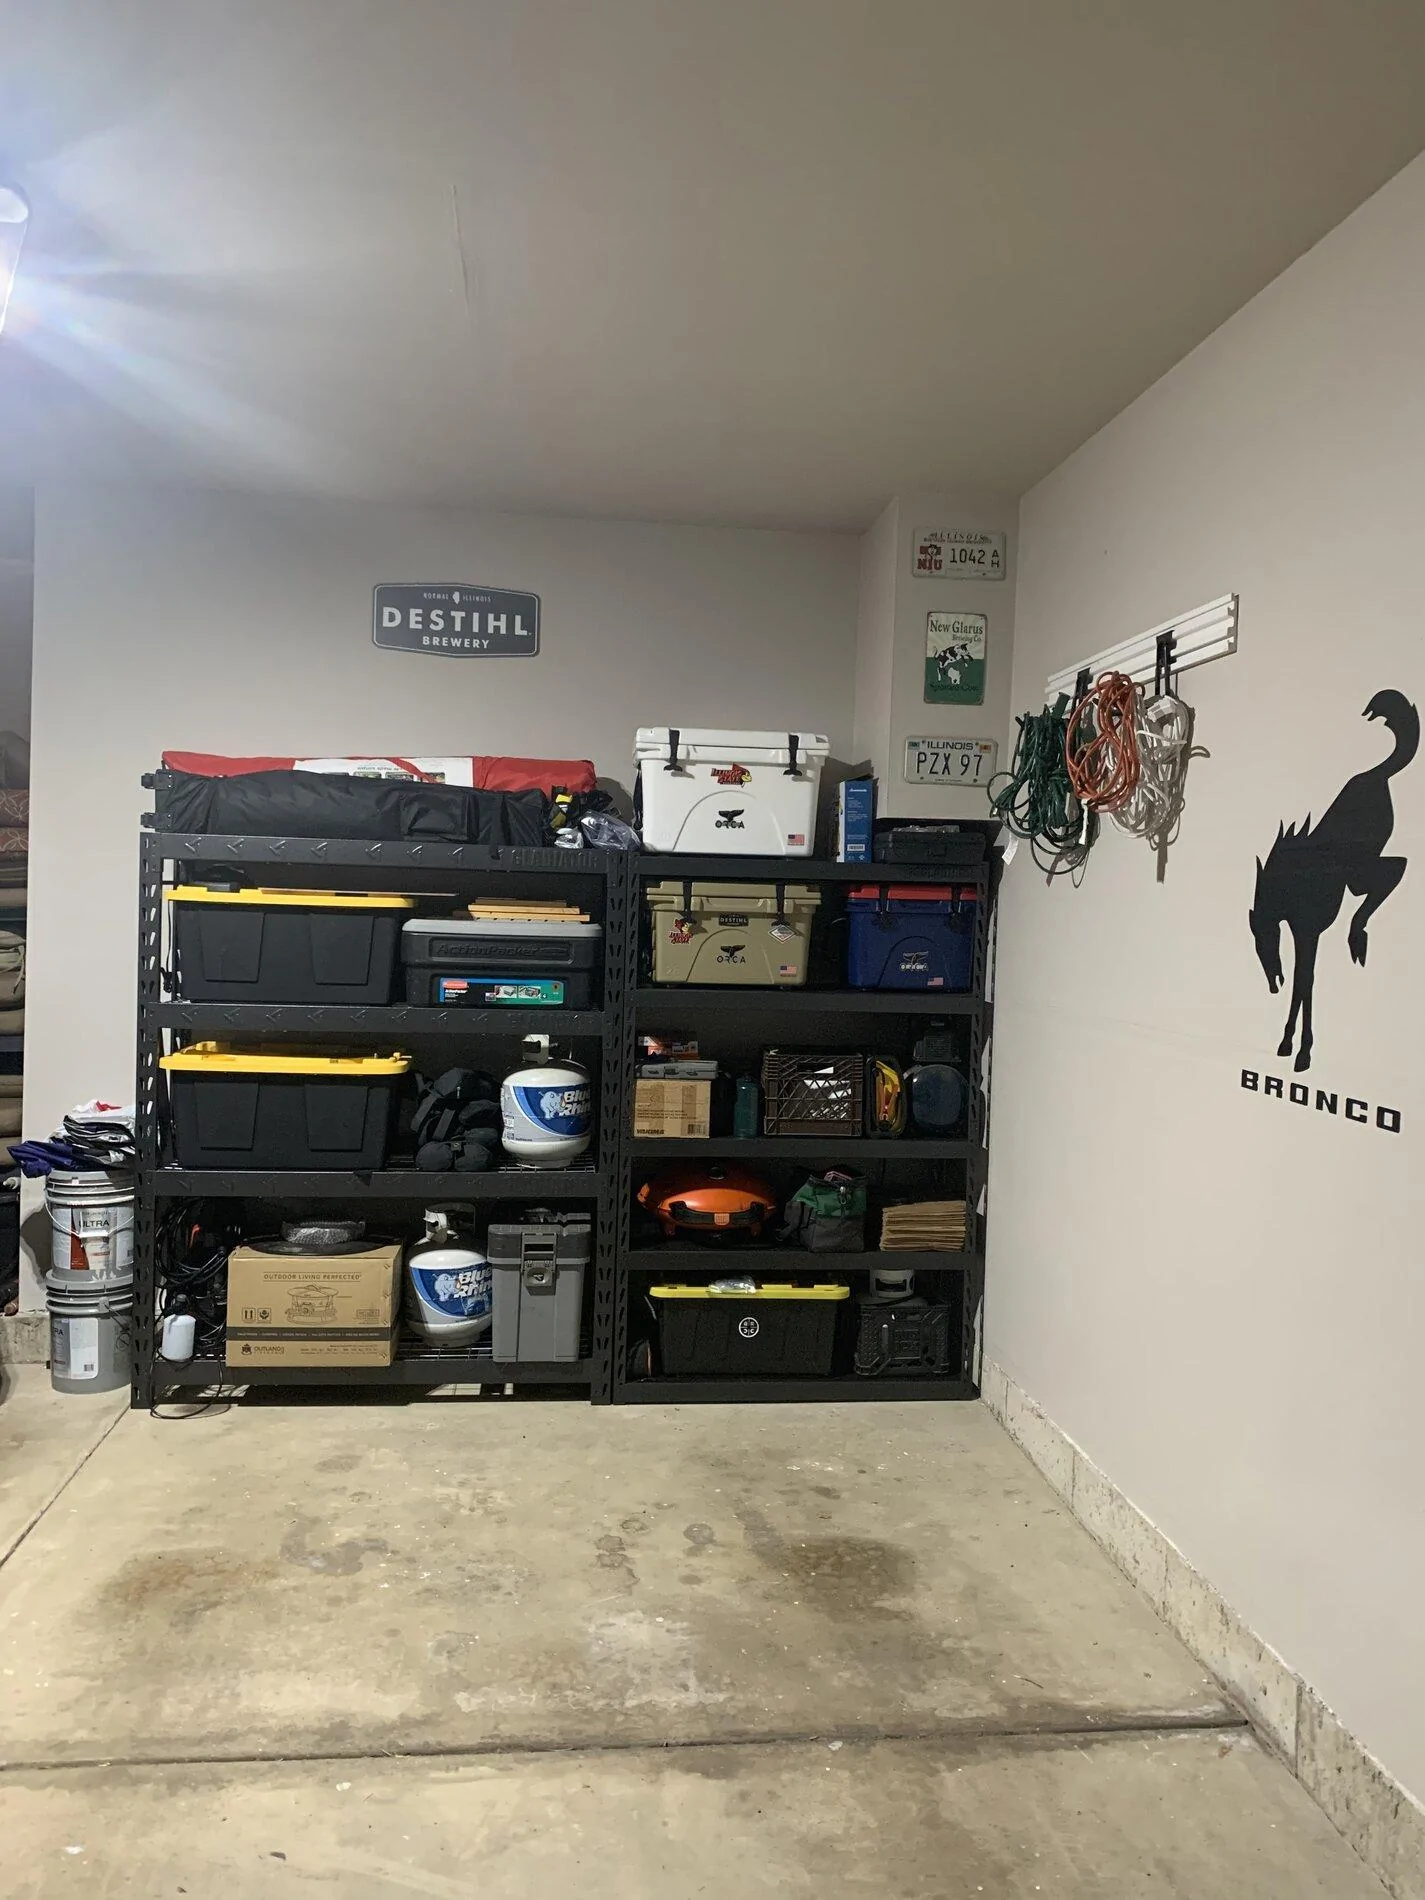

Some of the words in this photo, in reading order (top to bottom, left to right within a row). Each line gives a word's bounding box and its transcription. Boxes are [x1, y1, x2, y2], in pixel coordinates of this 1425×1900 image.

[949, 548, 986, 564] 1042
[917, 558, 943, 571] NIU
[382, 606, 528, 636] DESTIHL
[930, 620, 951, 632] New
[952, 621, 983, 634] Glarus
[422, 636, 490, 649] BREWERY
[927, 741, 974, 750] ILLINOIS
[917, 752, 951, 775] PZX
[960, 754, 983, 776] 97
[715, 820, 745, 829] ORCA
[717, 956, 746, 964] ORCA
[1241, 1069, 1401, 1133] BRONCO
